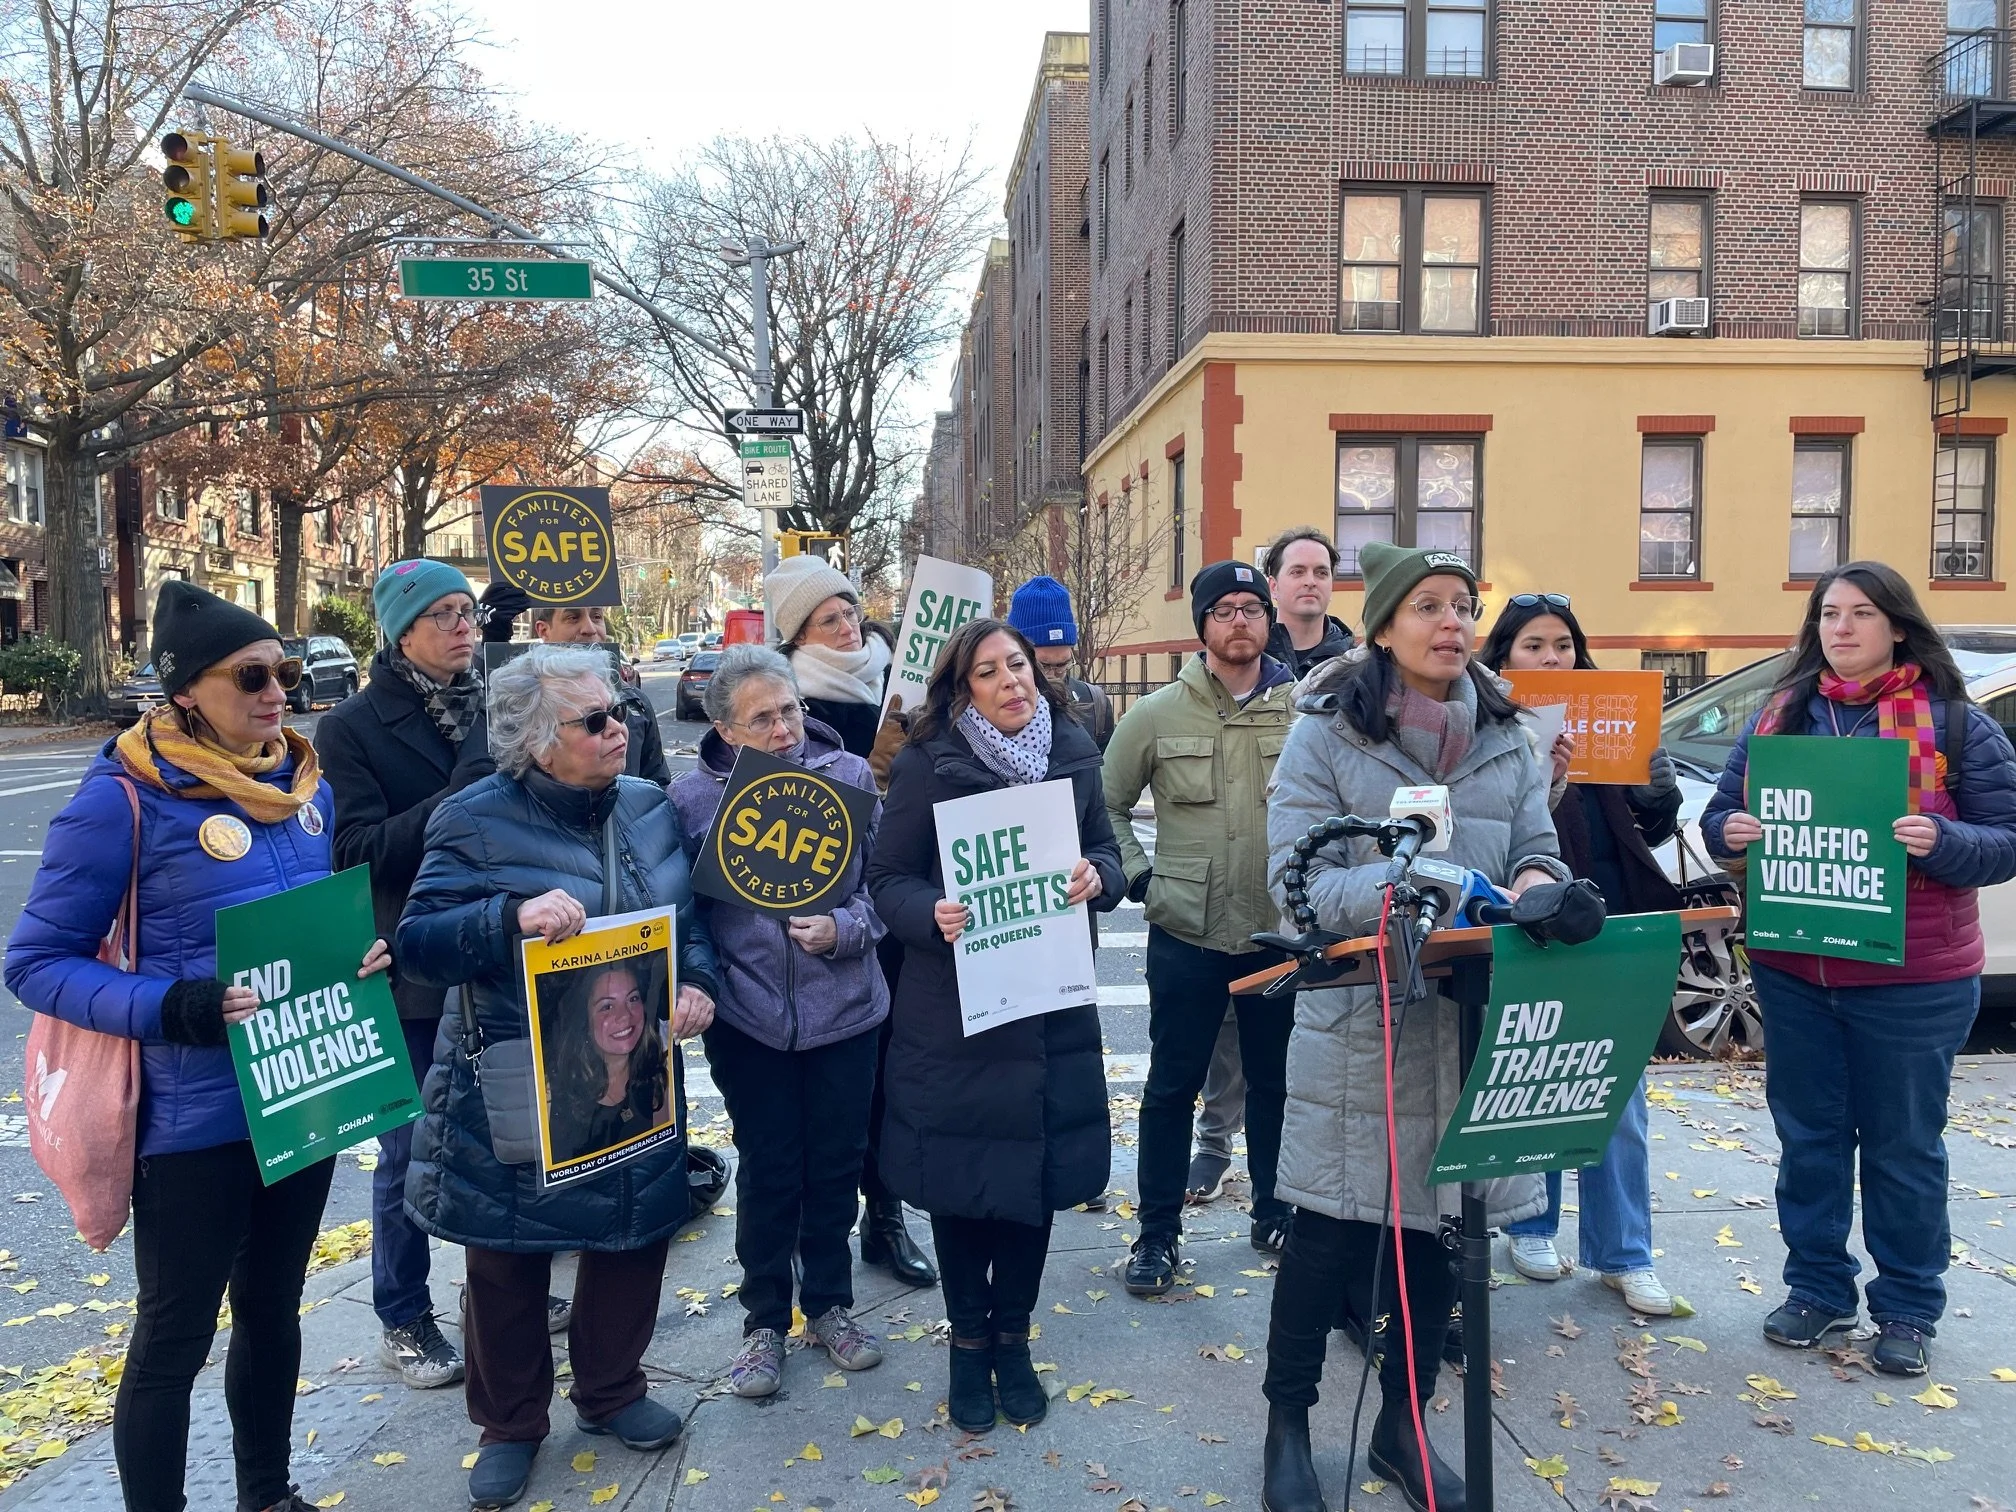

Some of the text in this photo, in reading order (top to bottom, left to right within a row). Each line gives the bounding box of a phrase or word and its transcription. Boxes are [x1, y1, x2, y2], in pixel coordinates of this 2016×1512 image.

[467, 267, 528, 292] 35 St
[737, 416, 793, 426] ONE WAY
[744, 445, 787, 455] BIKE ROUTE
[746, 478, 788, 489] SHARED
[754, 492, 781, 502] LANE
[507, 499, 590, 527] FAMILIES
[503, 531, 601, 563] SAFE
[516, 568, 594, 594] STREETS
[900, 670, 924, 684] FOR
[1592, 707, 1638, 721] CITY
[1593, 694, 1638, 710] CITY
[1592, 720, 1637, 734] CITY
[1592, 733, 1636, 747] CITY
[1592, 746, 1636, 760] CITY
[752, 782, 842, 831] FAMILIES
[787, 804, 809, 818] FOR
[1760, 787, 1812, 822] END
[728, 807, 842, 876] SAFE
[951, 825, 1029, 886] SAFE
[1761, 823, 1869, 862] TRAFFIC
[730, 854, 814, 899] STREETS
[1760, 859, 1885, 901] VIOLENCE
[958, 873, 1069, 932] STREETS
[965, 924, 1042, 955] FOR QUEENS
[1753, 930, 1780, 939] Cabán
[1822, 936, 1858, 947] ZOHRAN
[552, 941, 649, 970] KARINA LARINO
[239, 981, 353, 1055] TRAFFIC
[967, 1009, 989, 1022] Cabán
[1495, 1000, 1564, 1046] END
[250, 1017, 384, 1102] VIOLENCE
[1486, 1038, 1614, 1086] TRAFFIC
[1469, 1076, 1617, 1122] VIOLENCE
[265, 1112, 374, 1167] Cabán ZOHRAN
[550, 1165, 580, 1180] WORLD
[581, 1161, 596, 1174] DAY
[597, 1156, 607, 1165] OF
[608, 1134, 658, 1161] REMEMBERANCE
[1436, 1162, 1468, 1172] Cabán
[1515, 1152, 1556, 1163] ZOHRAN
